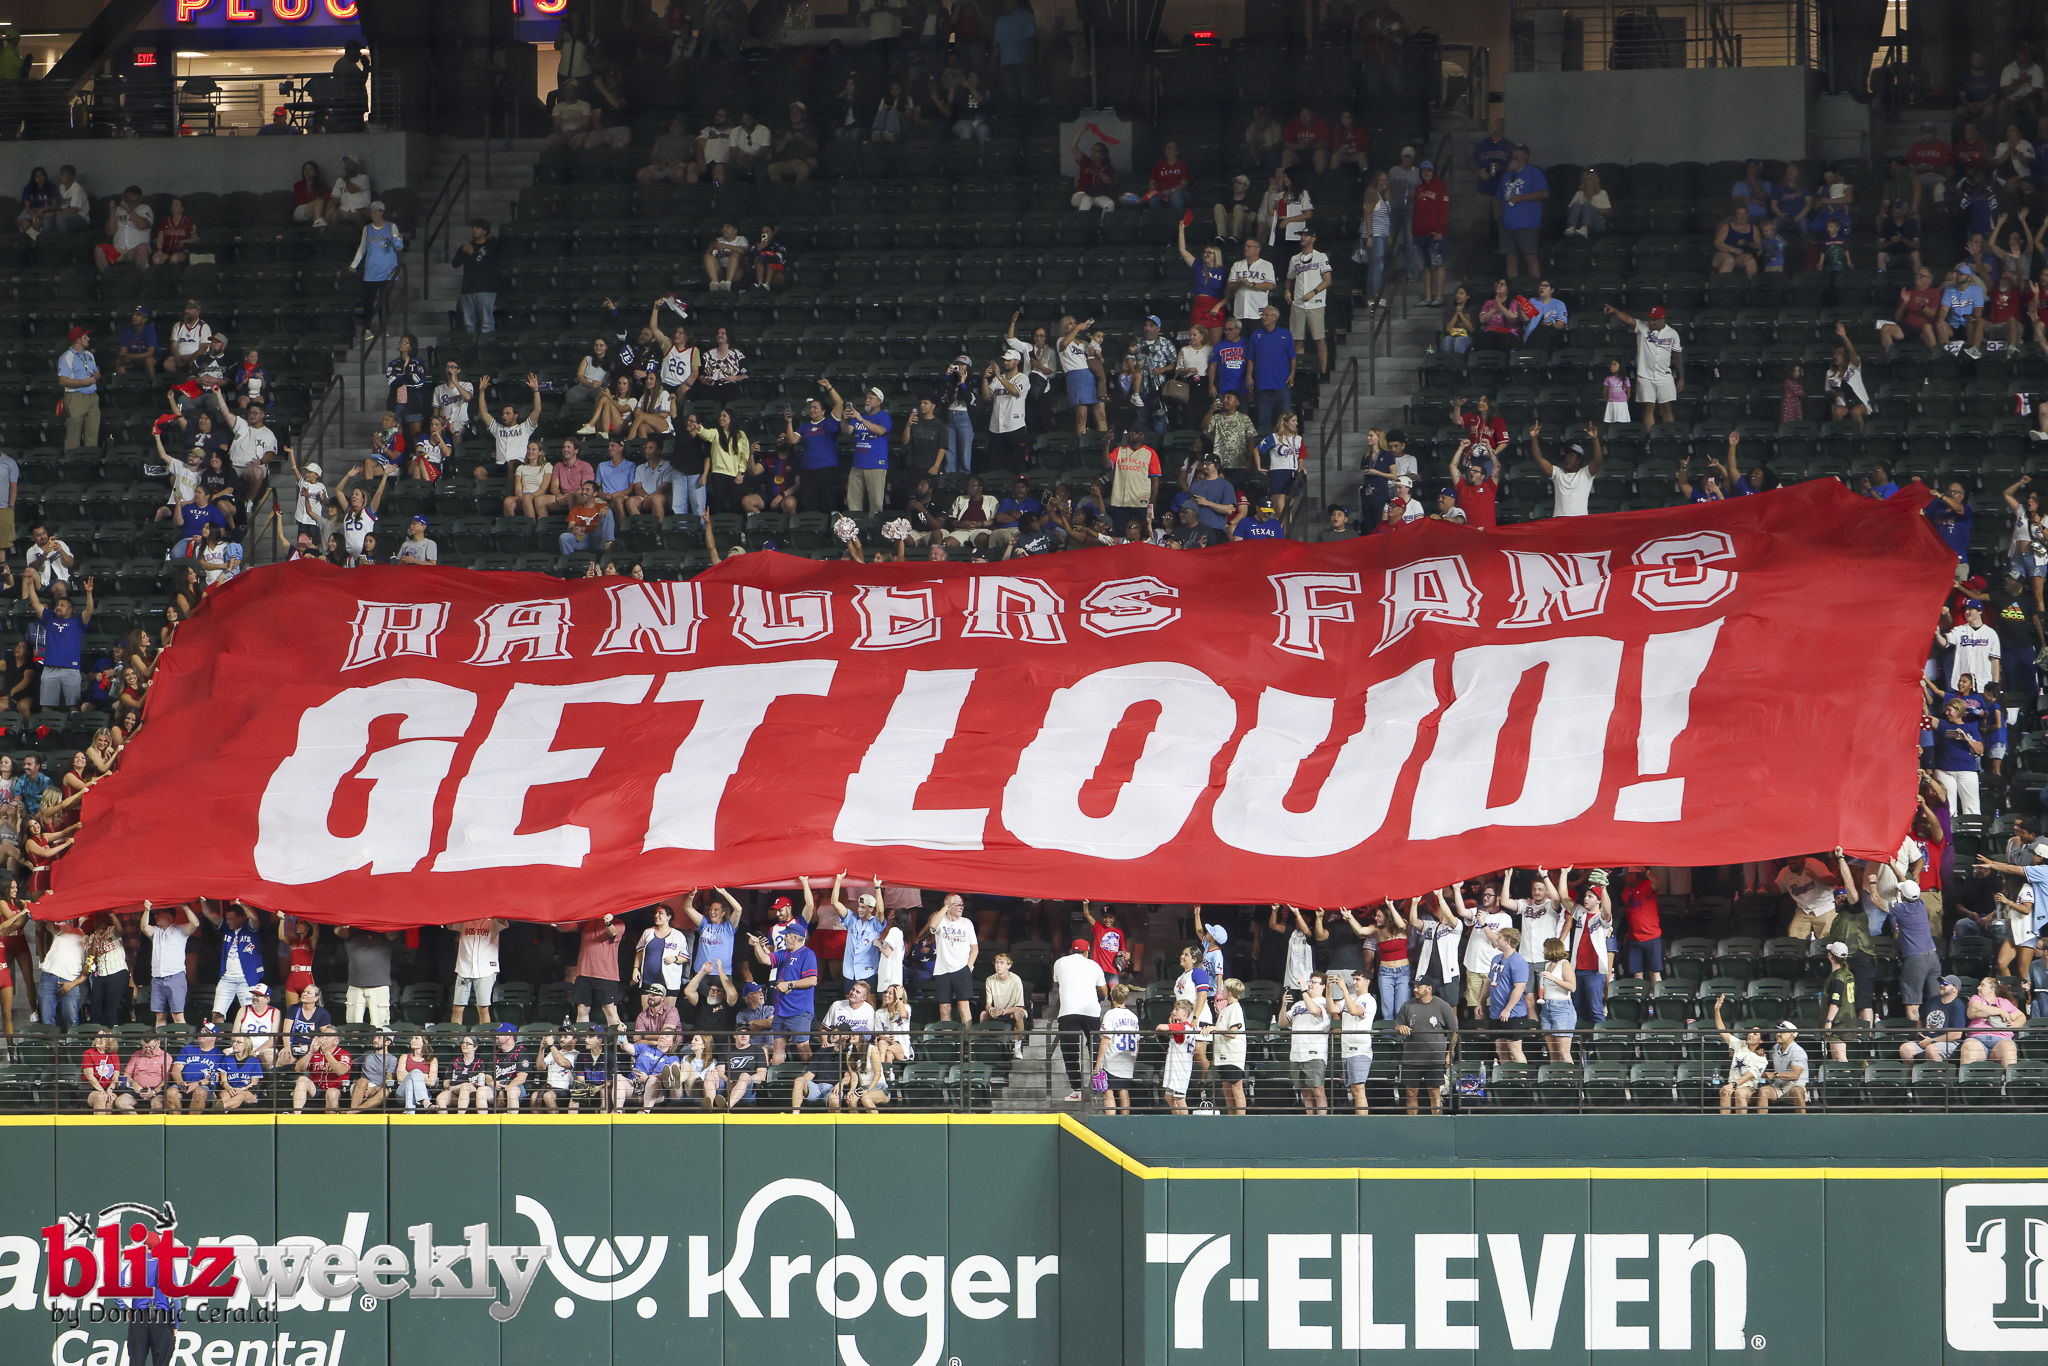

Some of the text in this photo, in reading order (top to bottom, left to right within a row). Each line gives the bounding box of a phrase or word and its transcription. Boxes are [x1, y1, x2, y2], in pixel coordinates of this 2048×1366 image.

[137, 53, 155, 67] EXIT
[968, 94, 979, 109] LA
[1160, 169, 1181, 177] TEXAS
[1236, 271, 1266, 281] TEXAS
[1218, 347, 1247, 363] TEXA
[669, 357, 687, 376] 26
[499, 429, 524, 439] TEXAS
[1117, 458, 1146, 468] AMERICAN
[1119, 464, 1141, 473] LEAGUE
[345, 518, 363, 532] 26
[1250, 527, 1275, 537] TEXAS
[340, 530, 1738, 672] RANGERS FANS
[2000, 609, 2026, 620] adidas
[1960, 635, 1989, 648] Rangers
[254, 617, 1725, 885] GET LOUD!
[464, 927, 490, 937] BOSTON
[942, 925, 967, 937] TEXAS
[837, 1015, 869, 1028] Rangers
[1114, 1018, 1139, 1029] LANGFORD
[1116, 1034, 1136, 1052] 36
[186, 1056, 216, 1070] BLUE JAYS
[688, 1177, 1059, 1366] Kroger
[52, 1329, 346, 1366] Ca Rental
